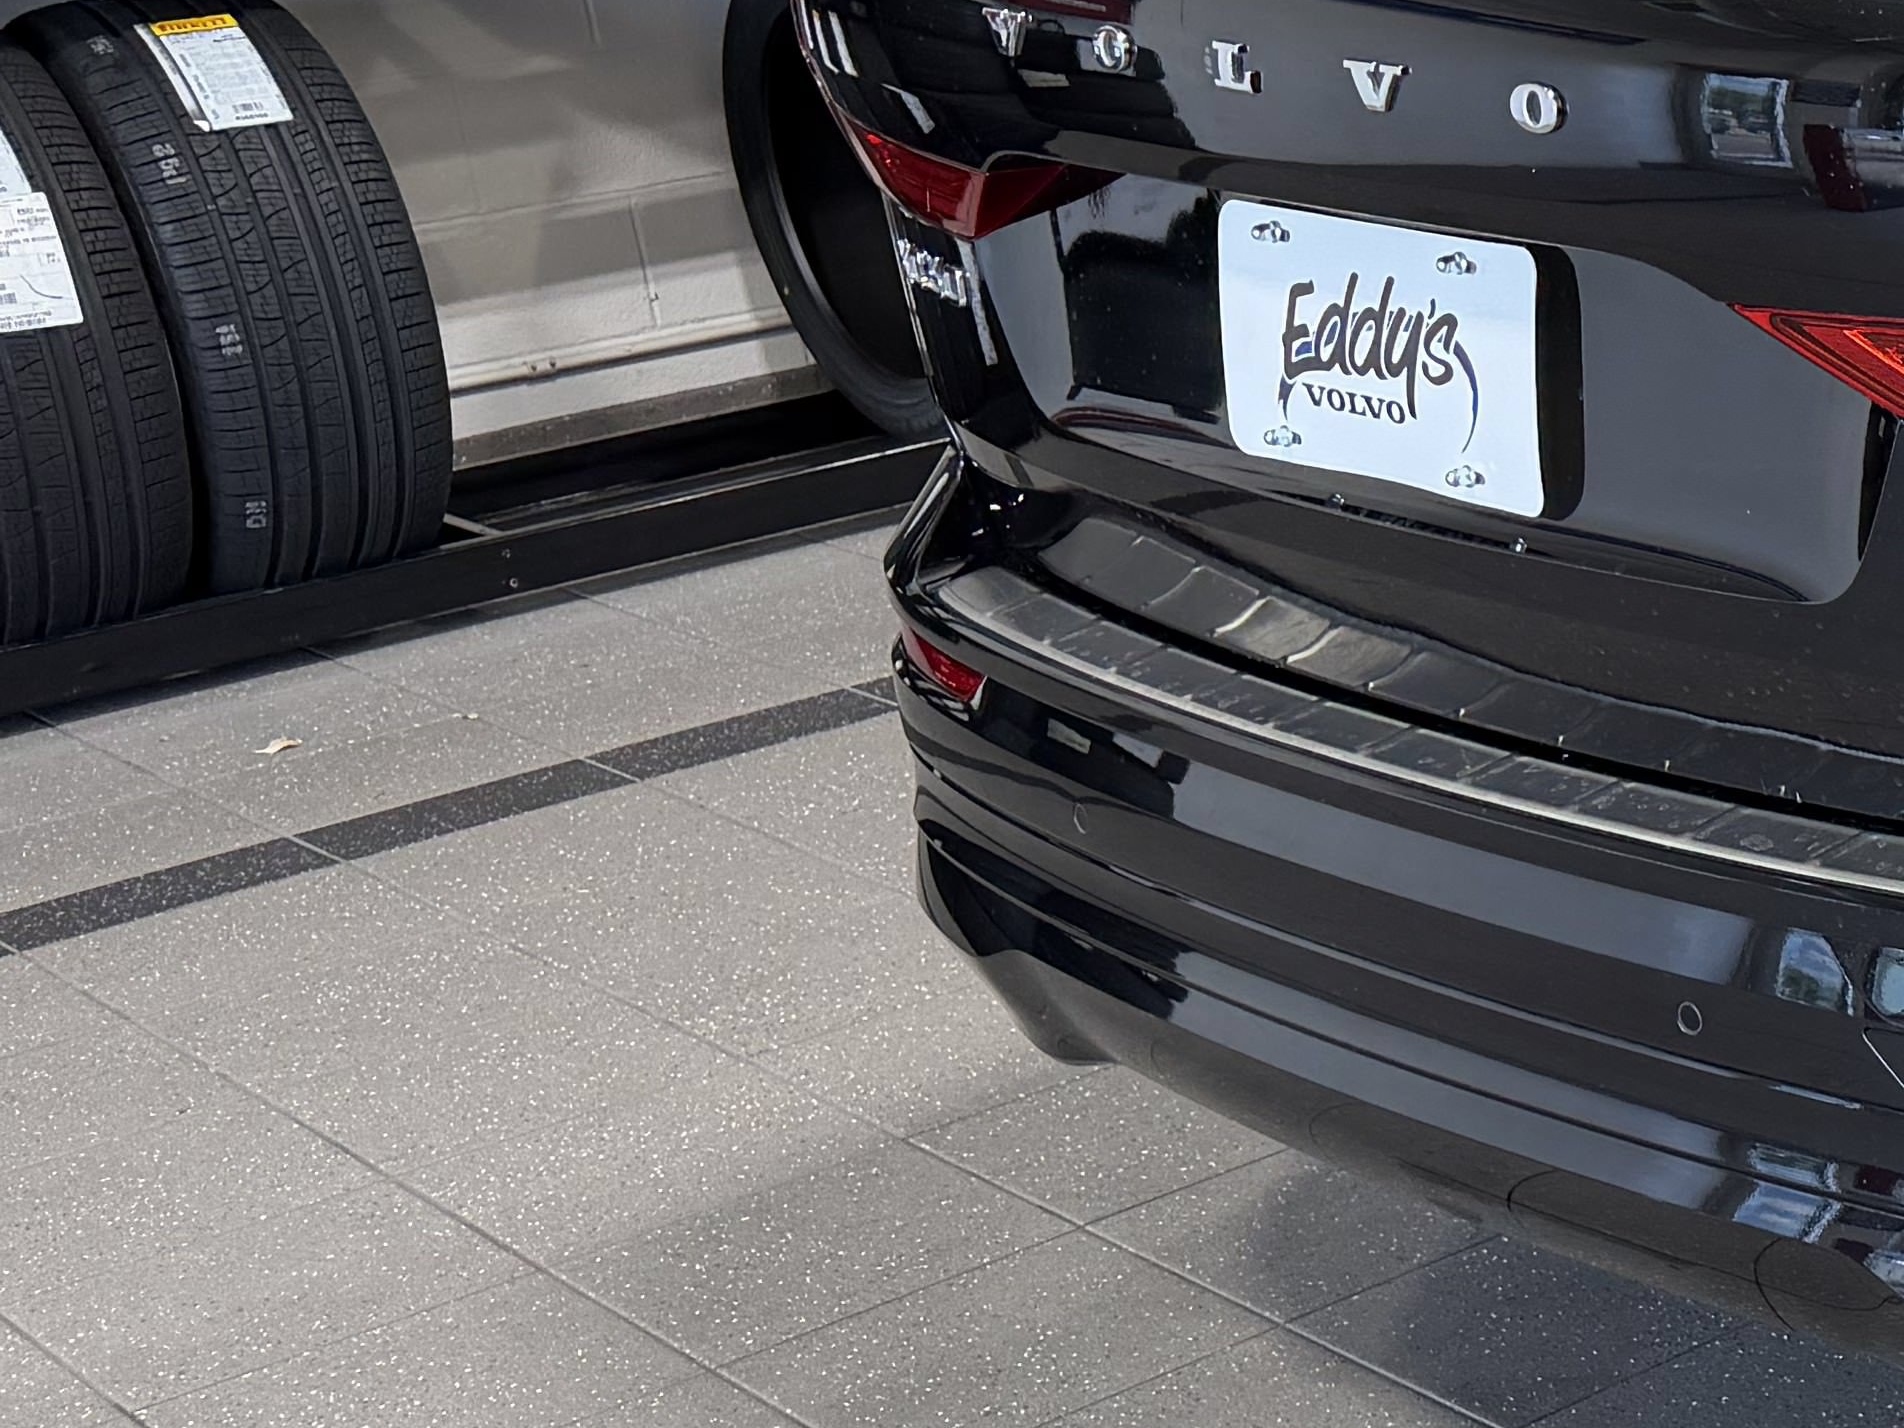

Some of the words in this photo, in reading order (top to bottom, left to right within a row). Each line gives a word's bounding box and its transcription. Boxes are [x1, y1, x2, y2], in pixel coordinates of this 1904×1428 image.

[981, 6, 1570, 135] VOLVO
[1282, 272, 1459, 421] Eddy's
[1302, 381, 1406, 425] VOLVO
